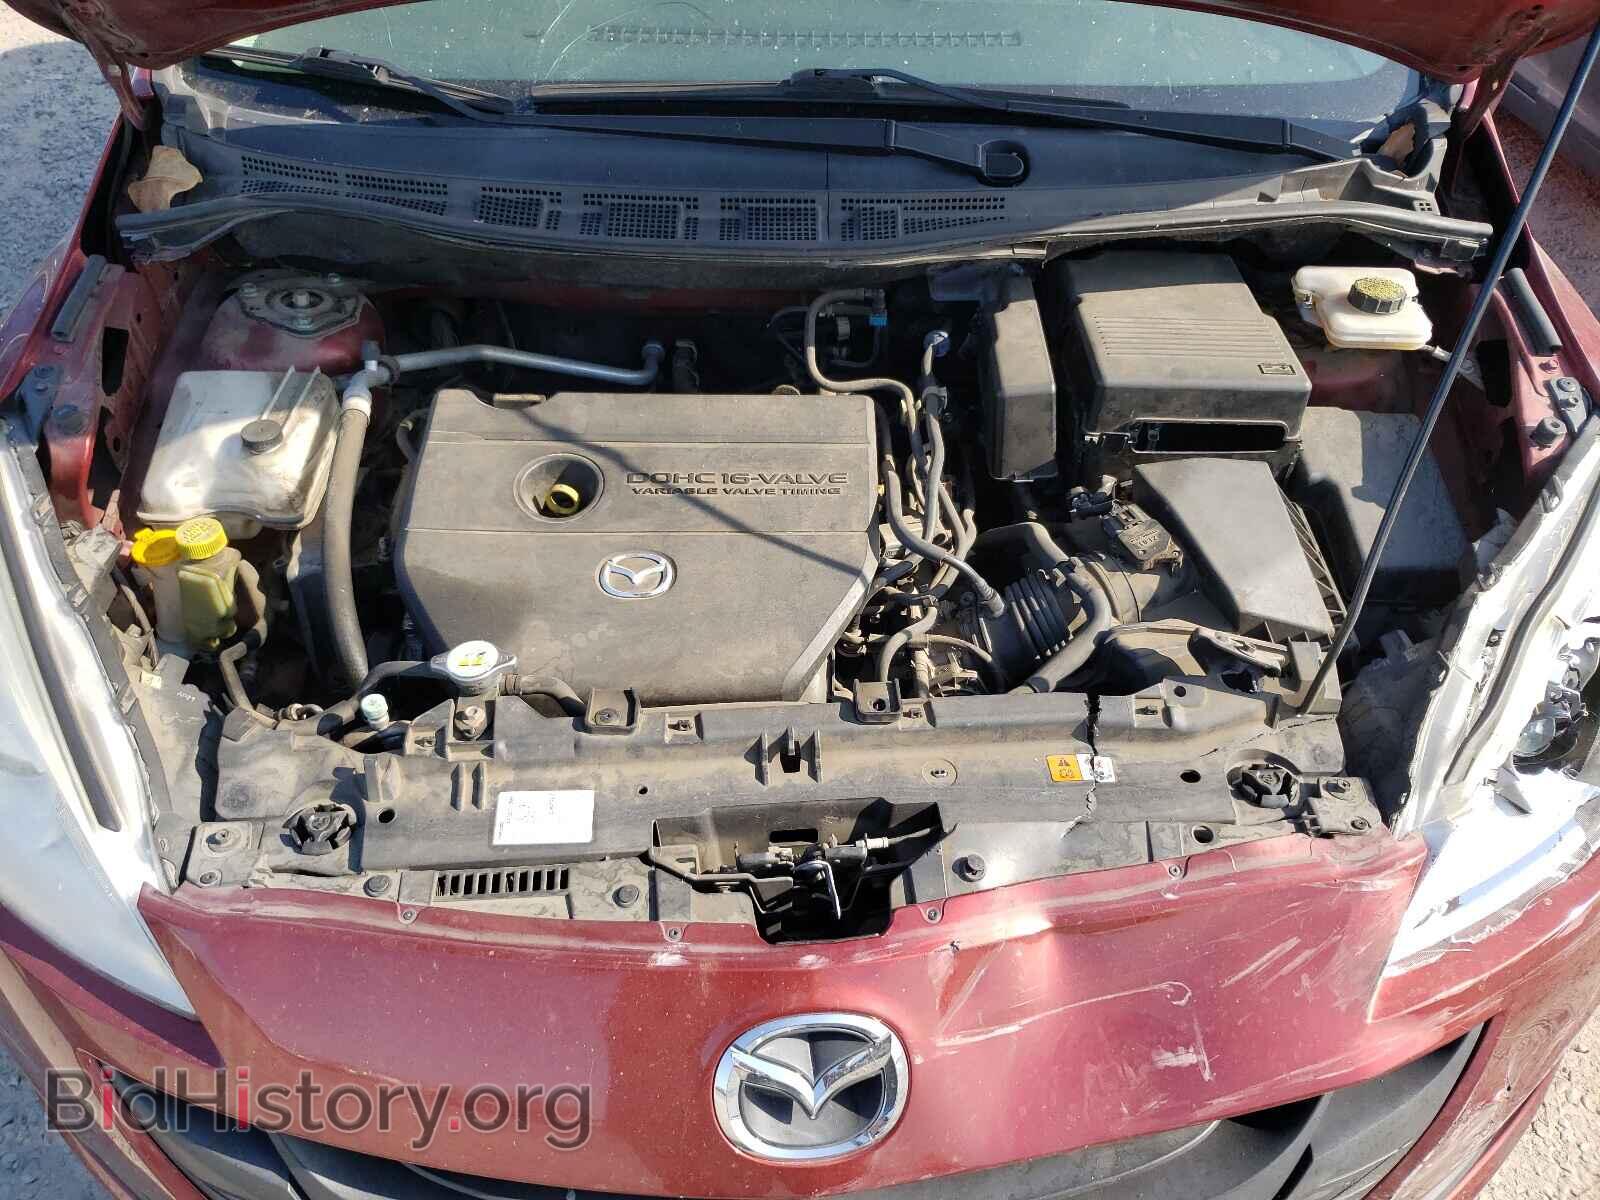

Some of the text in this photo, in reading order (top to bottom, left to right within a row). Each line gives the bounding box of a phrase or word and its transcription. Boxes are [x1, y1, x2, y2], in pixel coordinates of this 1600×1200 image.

[626, 472, 848, 485] DOHC 16-VALVE
[631, 487, 841, 495] VARIABLE VALVE TIMING
